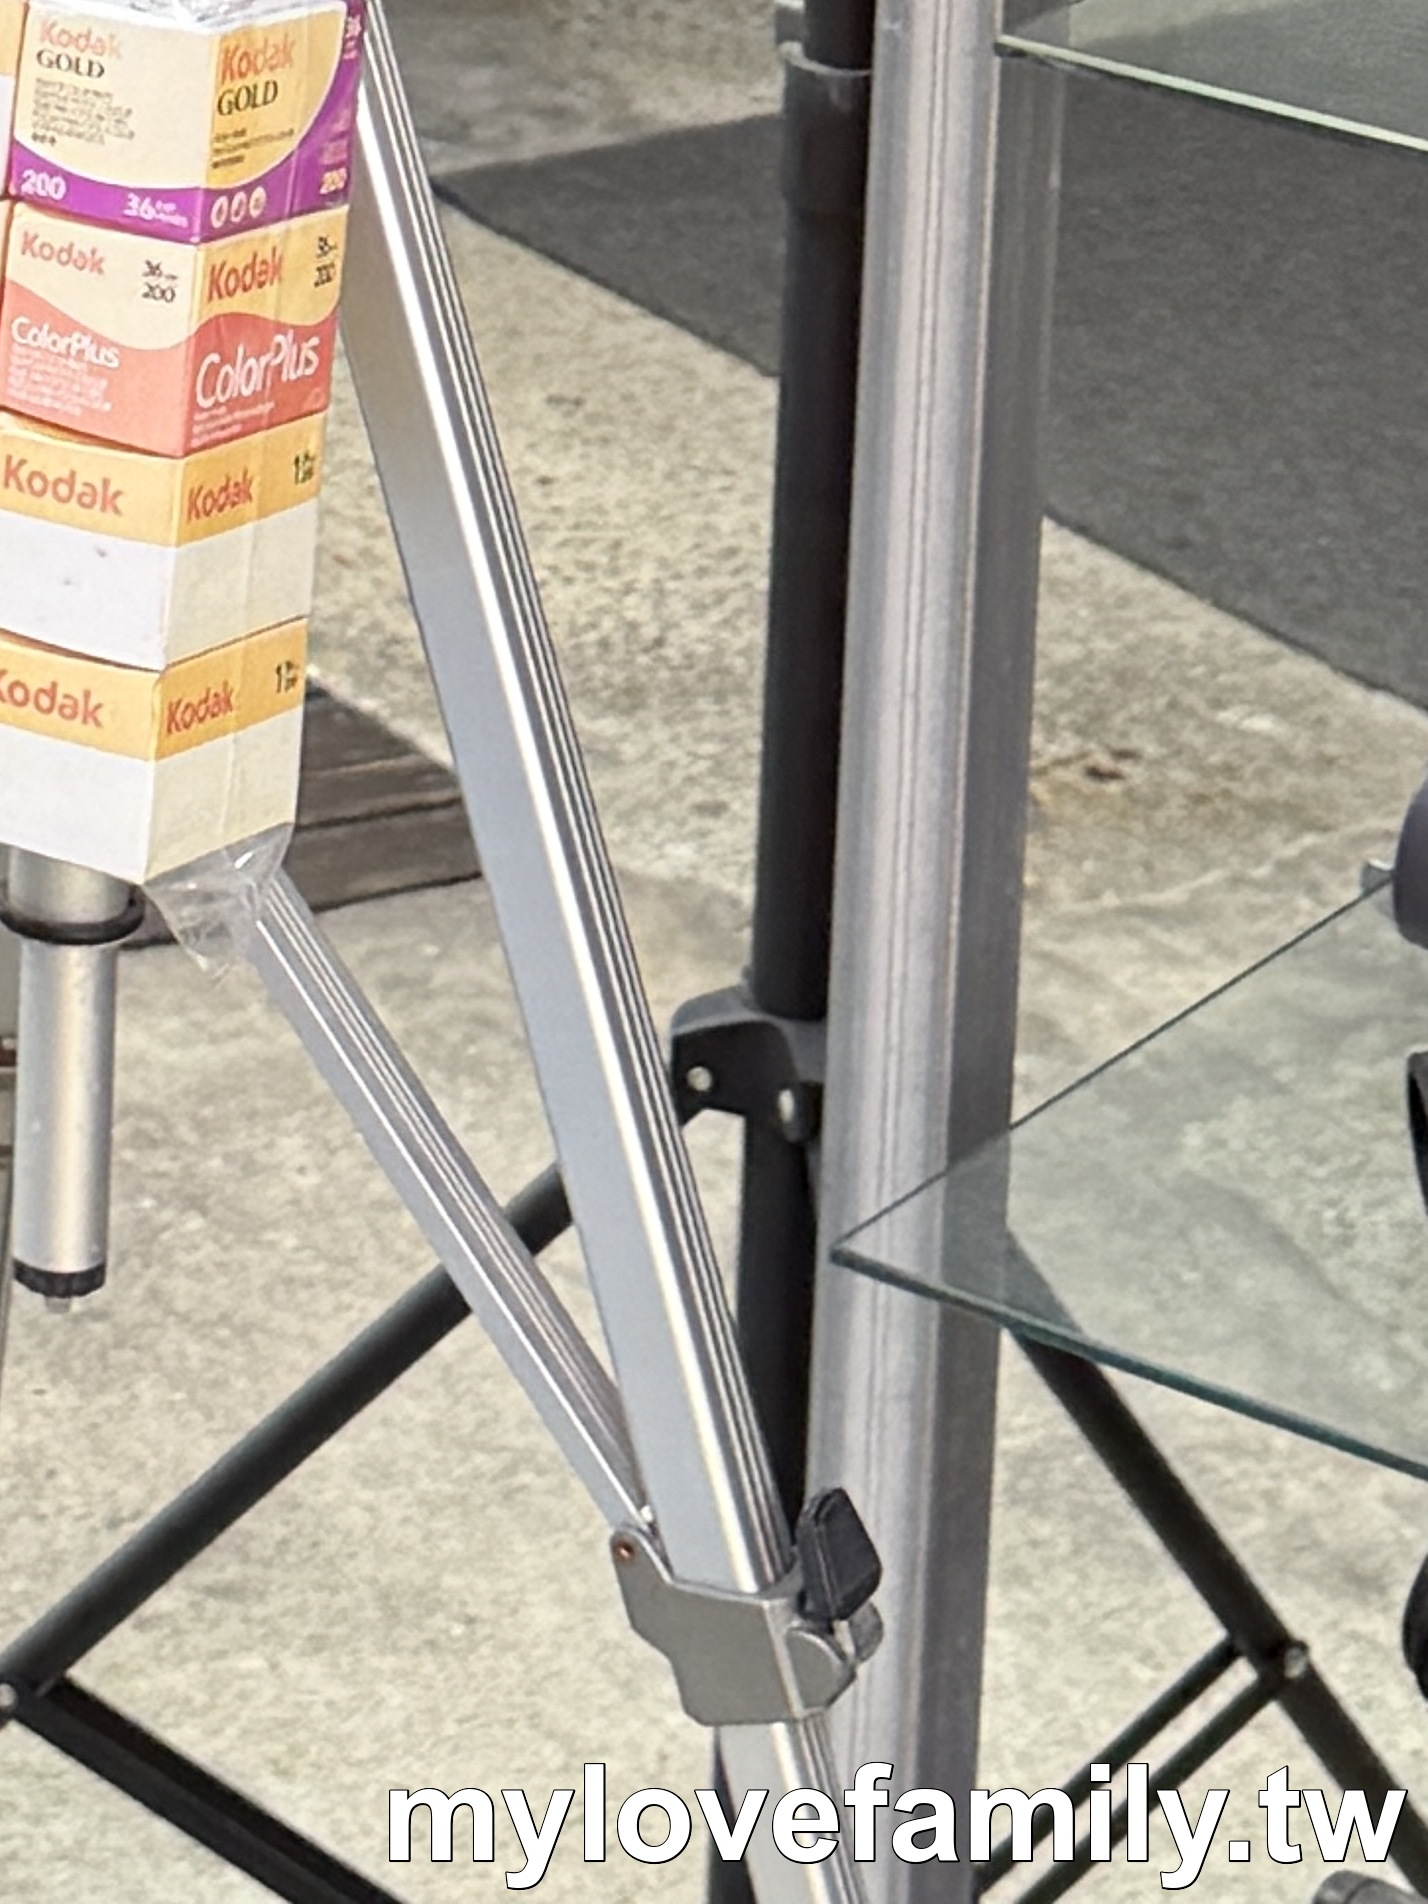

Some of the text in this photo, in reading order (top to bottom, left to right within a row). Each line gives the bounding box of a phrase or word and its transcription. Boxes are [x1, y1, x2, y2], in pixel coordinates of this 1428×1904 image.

[35, 48, 106, 79] GOLD
[40, 21, 123, 61] Kodak
[220, 32, 295, 87] Kodak
[217, 79, 279, 117] GOLD
[20, 168, 68, 202] 200
[20, 230, 106, 276] Kodak
[206, 244, 285, 303] Kodak
[140, 283, 177, 304] 200
[9, 315, 121, 369] ColorPlus
[195, 329, 321, 410] ColorPlus
[2, 453, 125, 517] Kodak
[186, 468, 255, 522] Kodak
[164, 682, 235, 737] Kodak
